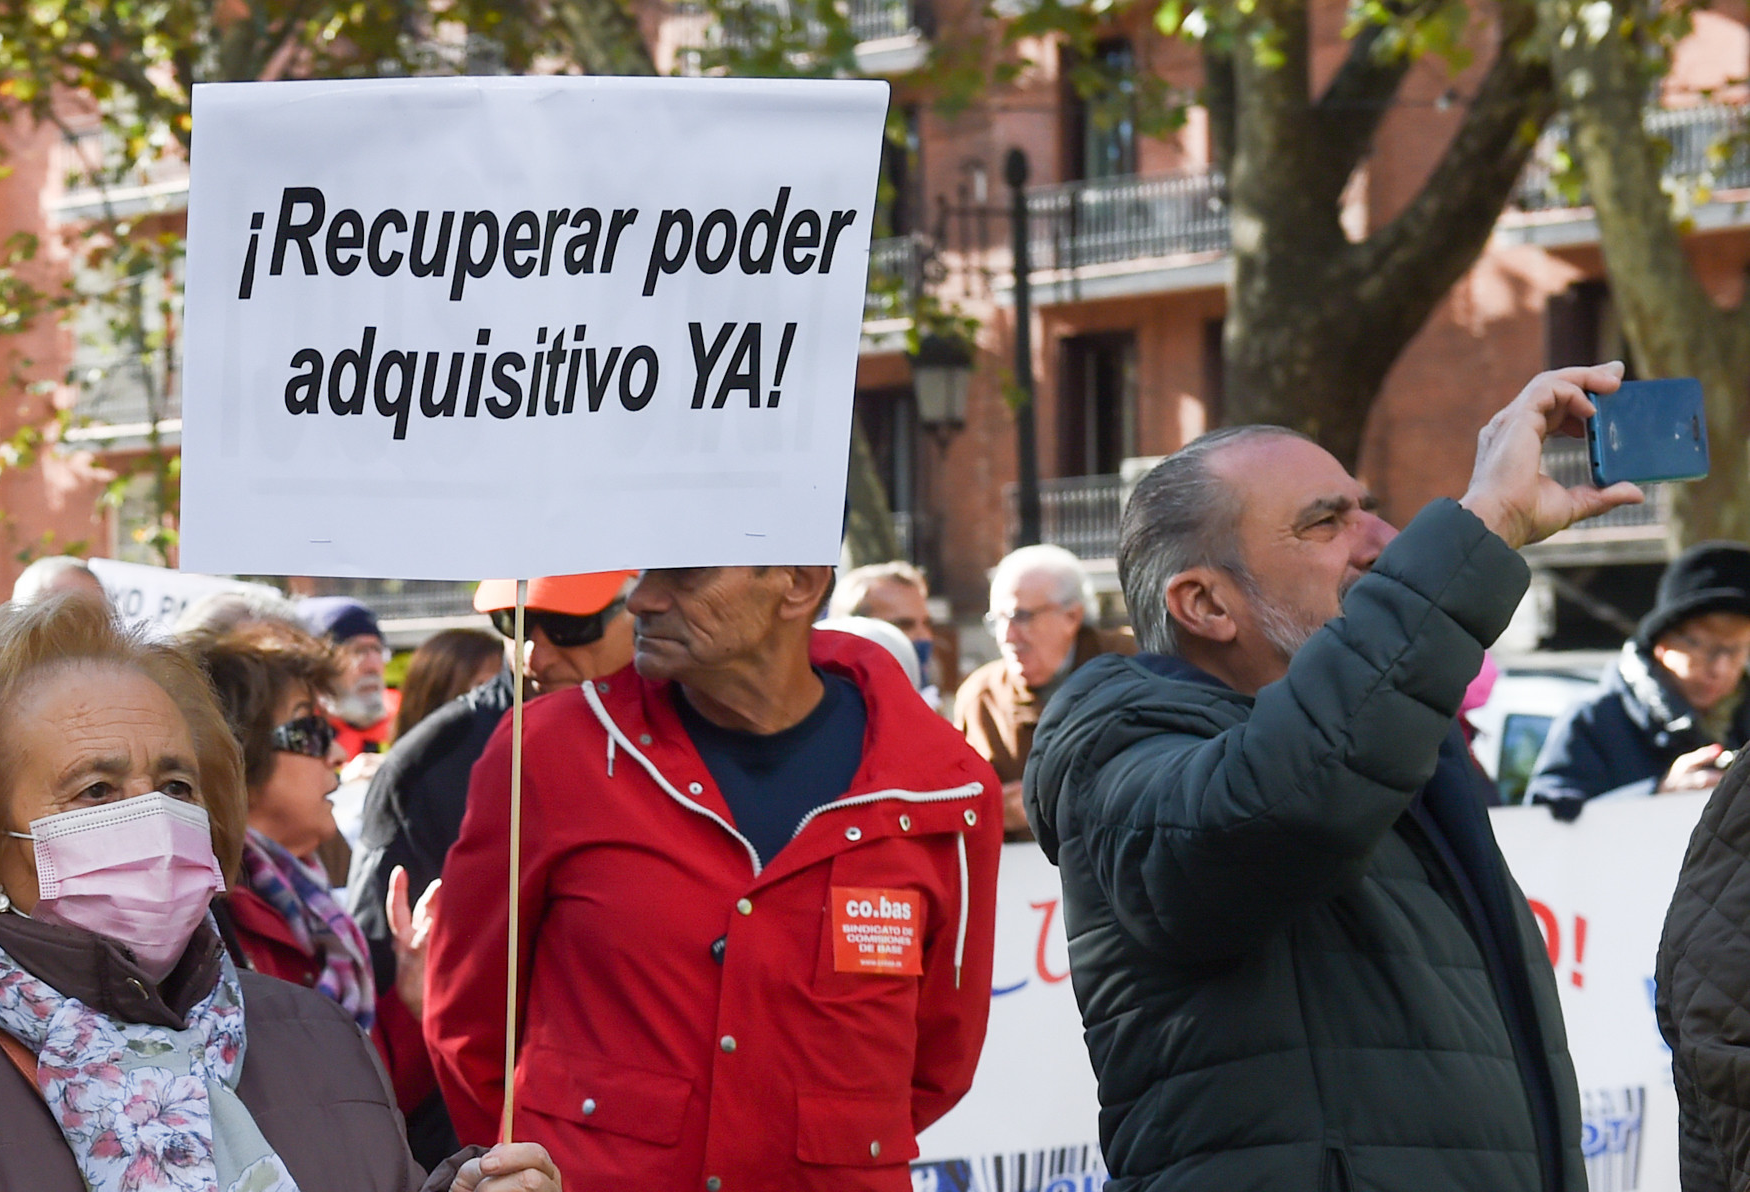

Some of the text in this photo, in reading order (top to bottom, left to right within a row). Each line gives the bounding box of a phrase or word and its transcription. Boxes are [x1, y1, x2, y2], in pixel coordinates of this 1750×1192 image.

[238, 186, 858, 302] ¡Recuperar poder
[284, 321, 798, 441] adquisitivo YA!
[846, 895, 911, 920] co.bas
[842, 925, 913, 937] SINDICATO DE
[846, 934, 911, 945] COMISIONES
[858, 944, 902, 954] DE BASE
